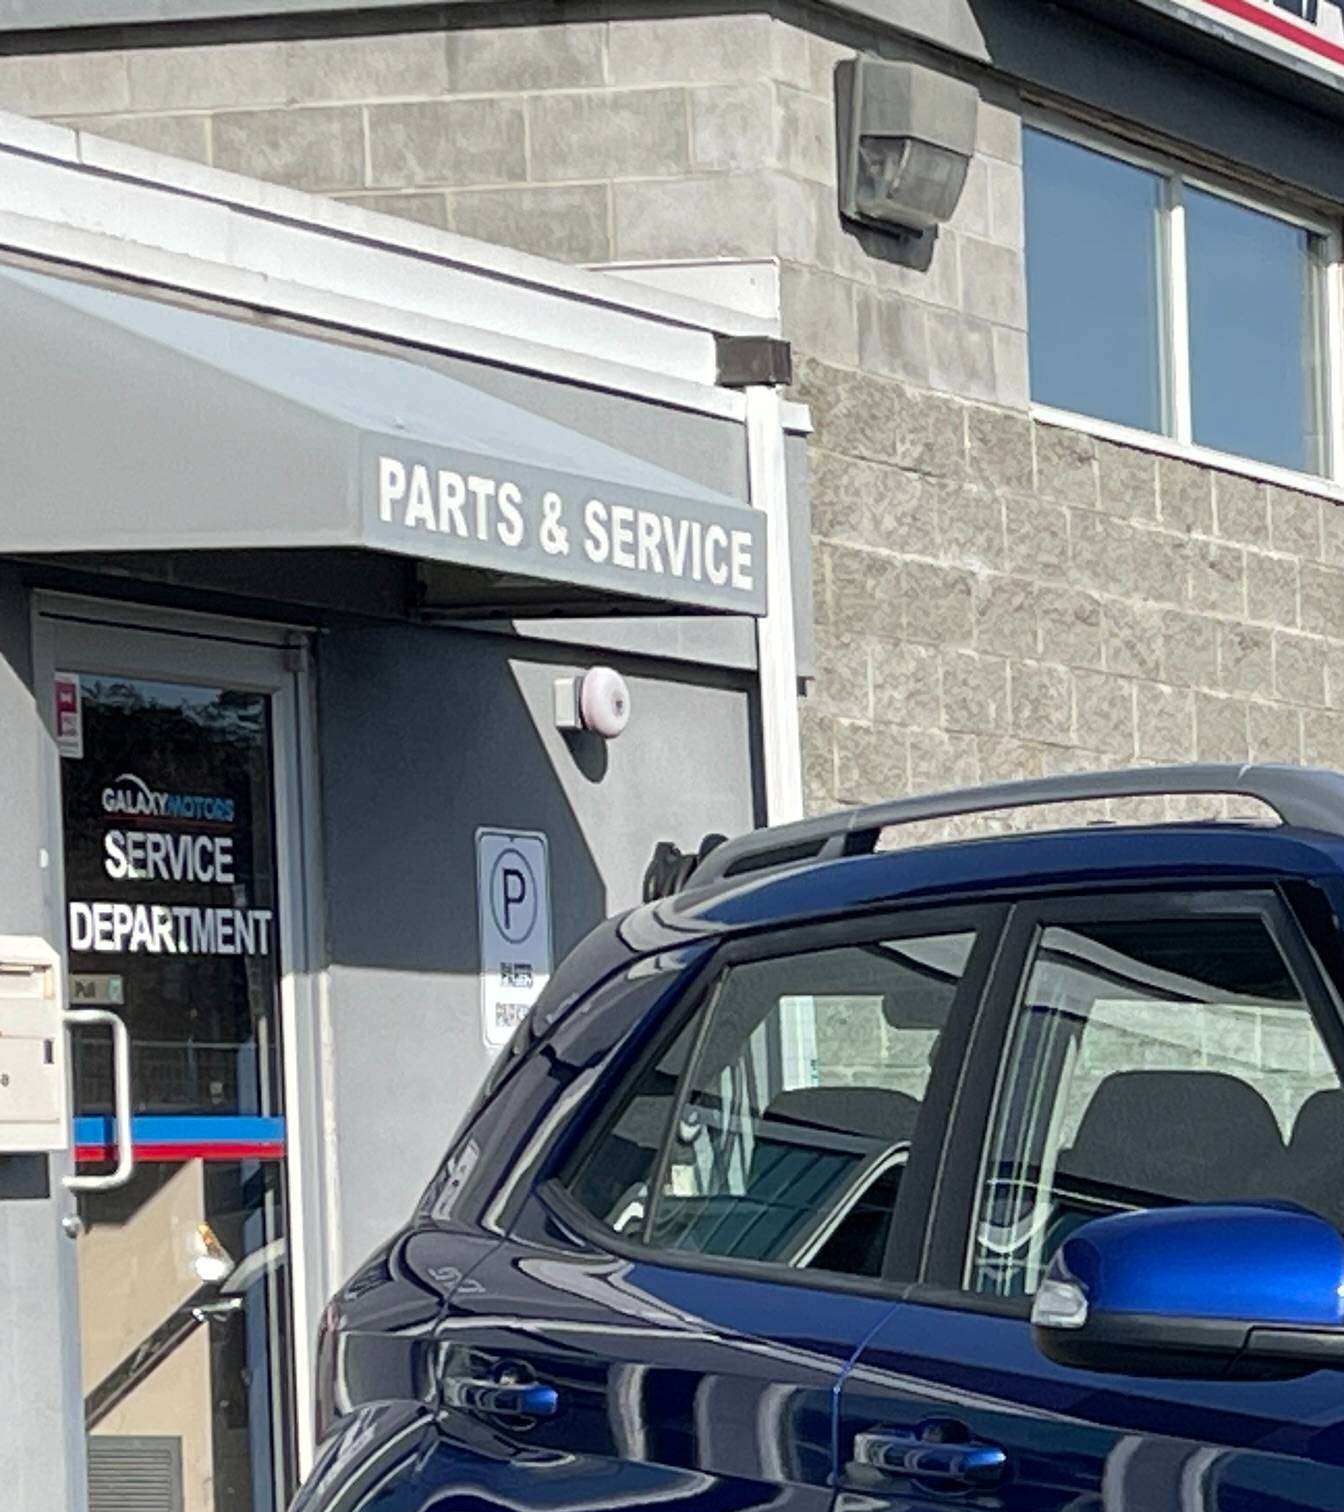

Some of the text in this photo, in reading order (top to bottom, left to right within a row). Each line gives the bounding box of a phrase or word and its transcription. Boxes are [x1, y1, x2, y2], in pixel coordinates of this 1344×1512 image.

[378, 456, 755, 591] PARTS & SERVICE
[104, 829, 235, 883] SERVICE
[502, 867, 526, 930] P
[68, 902, 273, 955] DEPARTMENT
